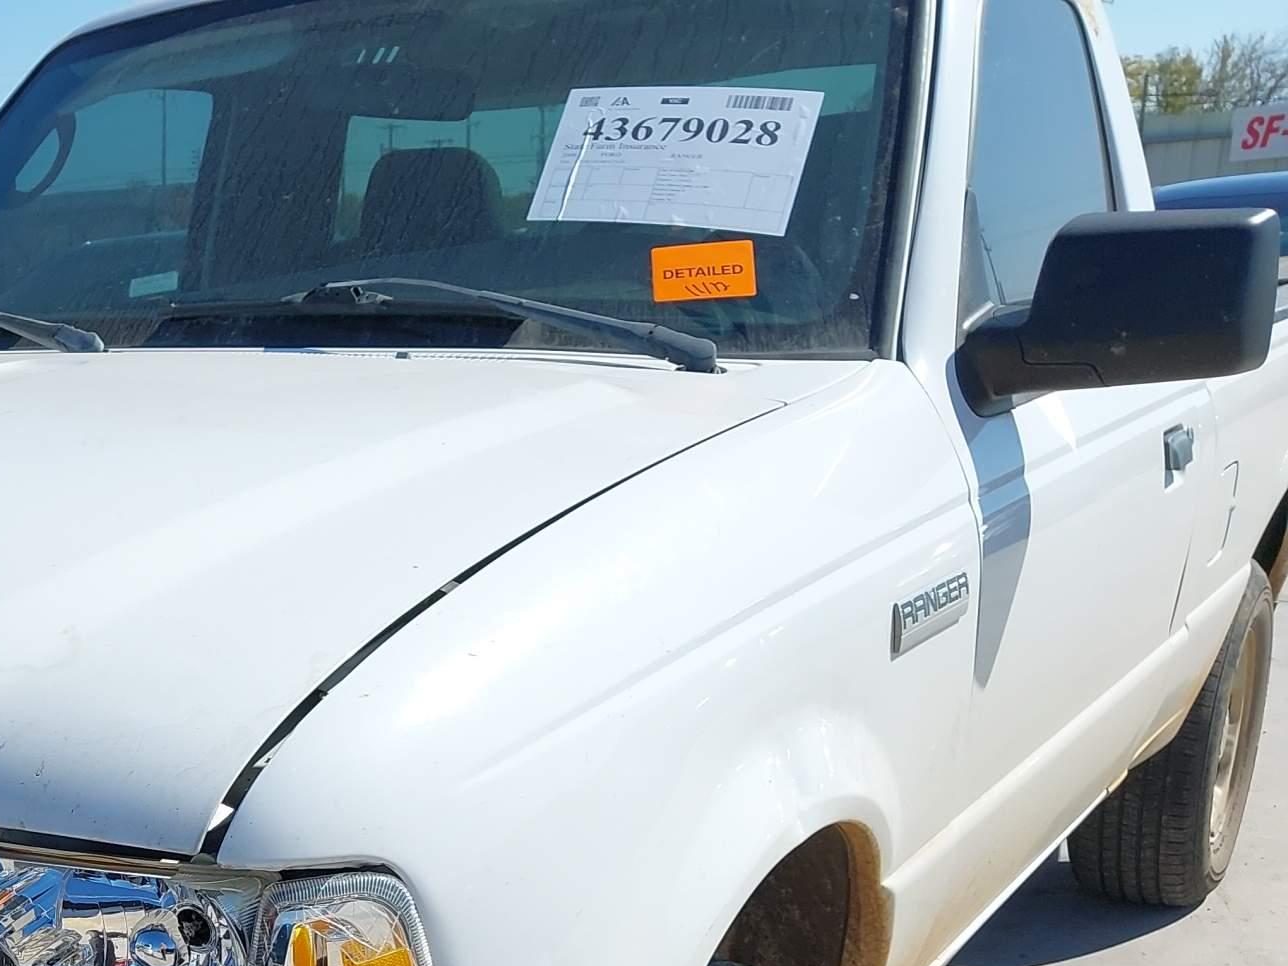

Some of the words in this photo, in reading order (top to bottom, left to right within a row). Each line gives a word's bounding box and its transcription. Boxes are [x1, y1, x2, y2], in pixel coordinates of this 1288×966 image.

[582, 116, 782, 147] 43679028
[663, 264, 744, 280] DETAILED
[900, 571, 970, 631] RANGER
